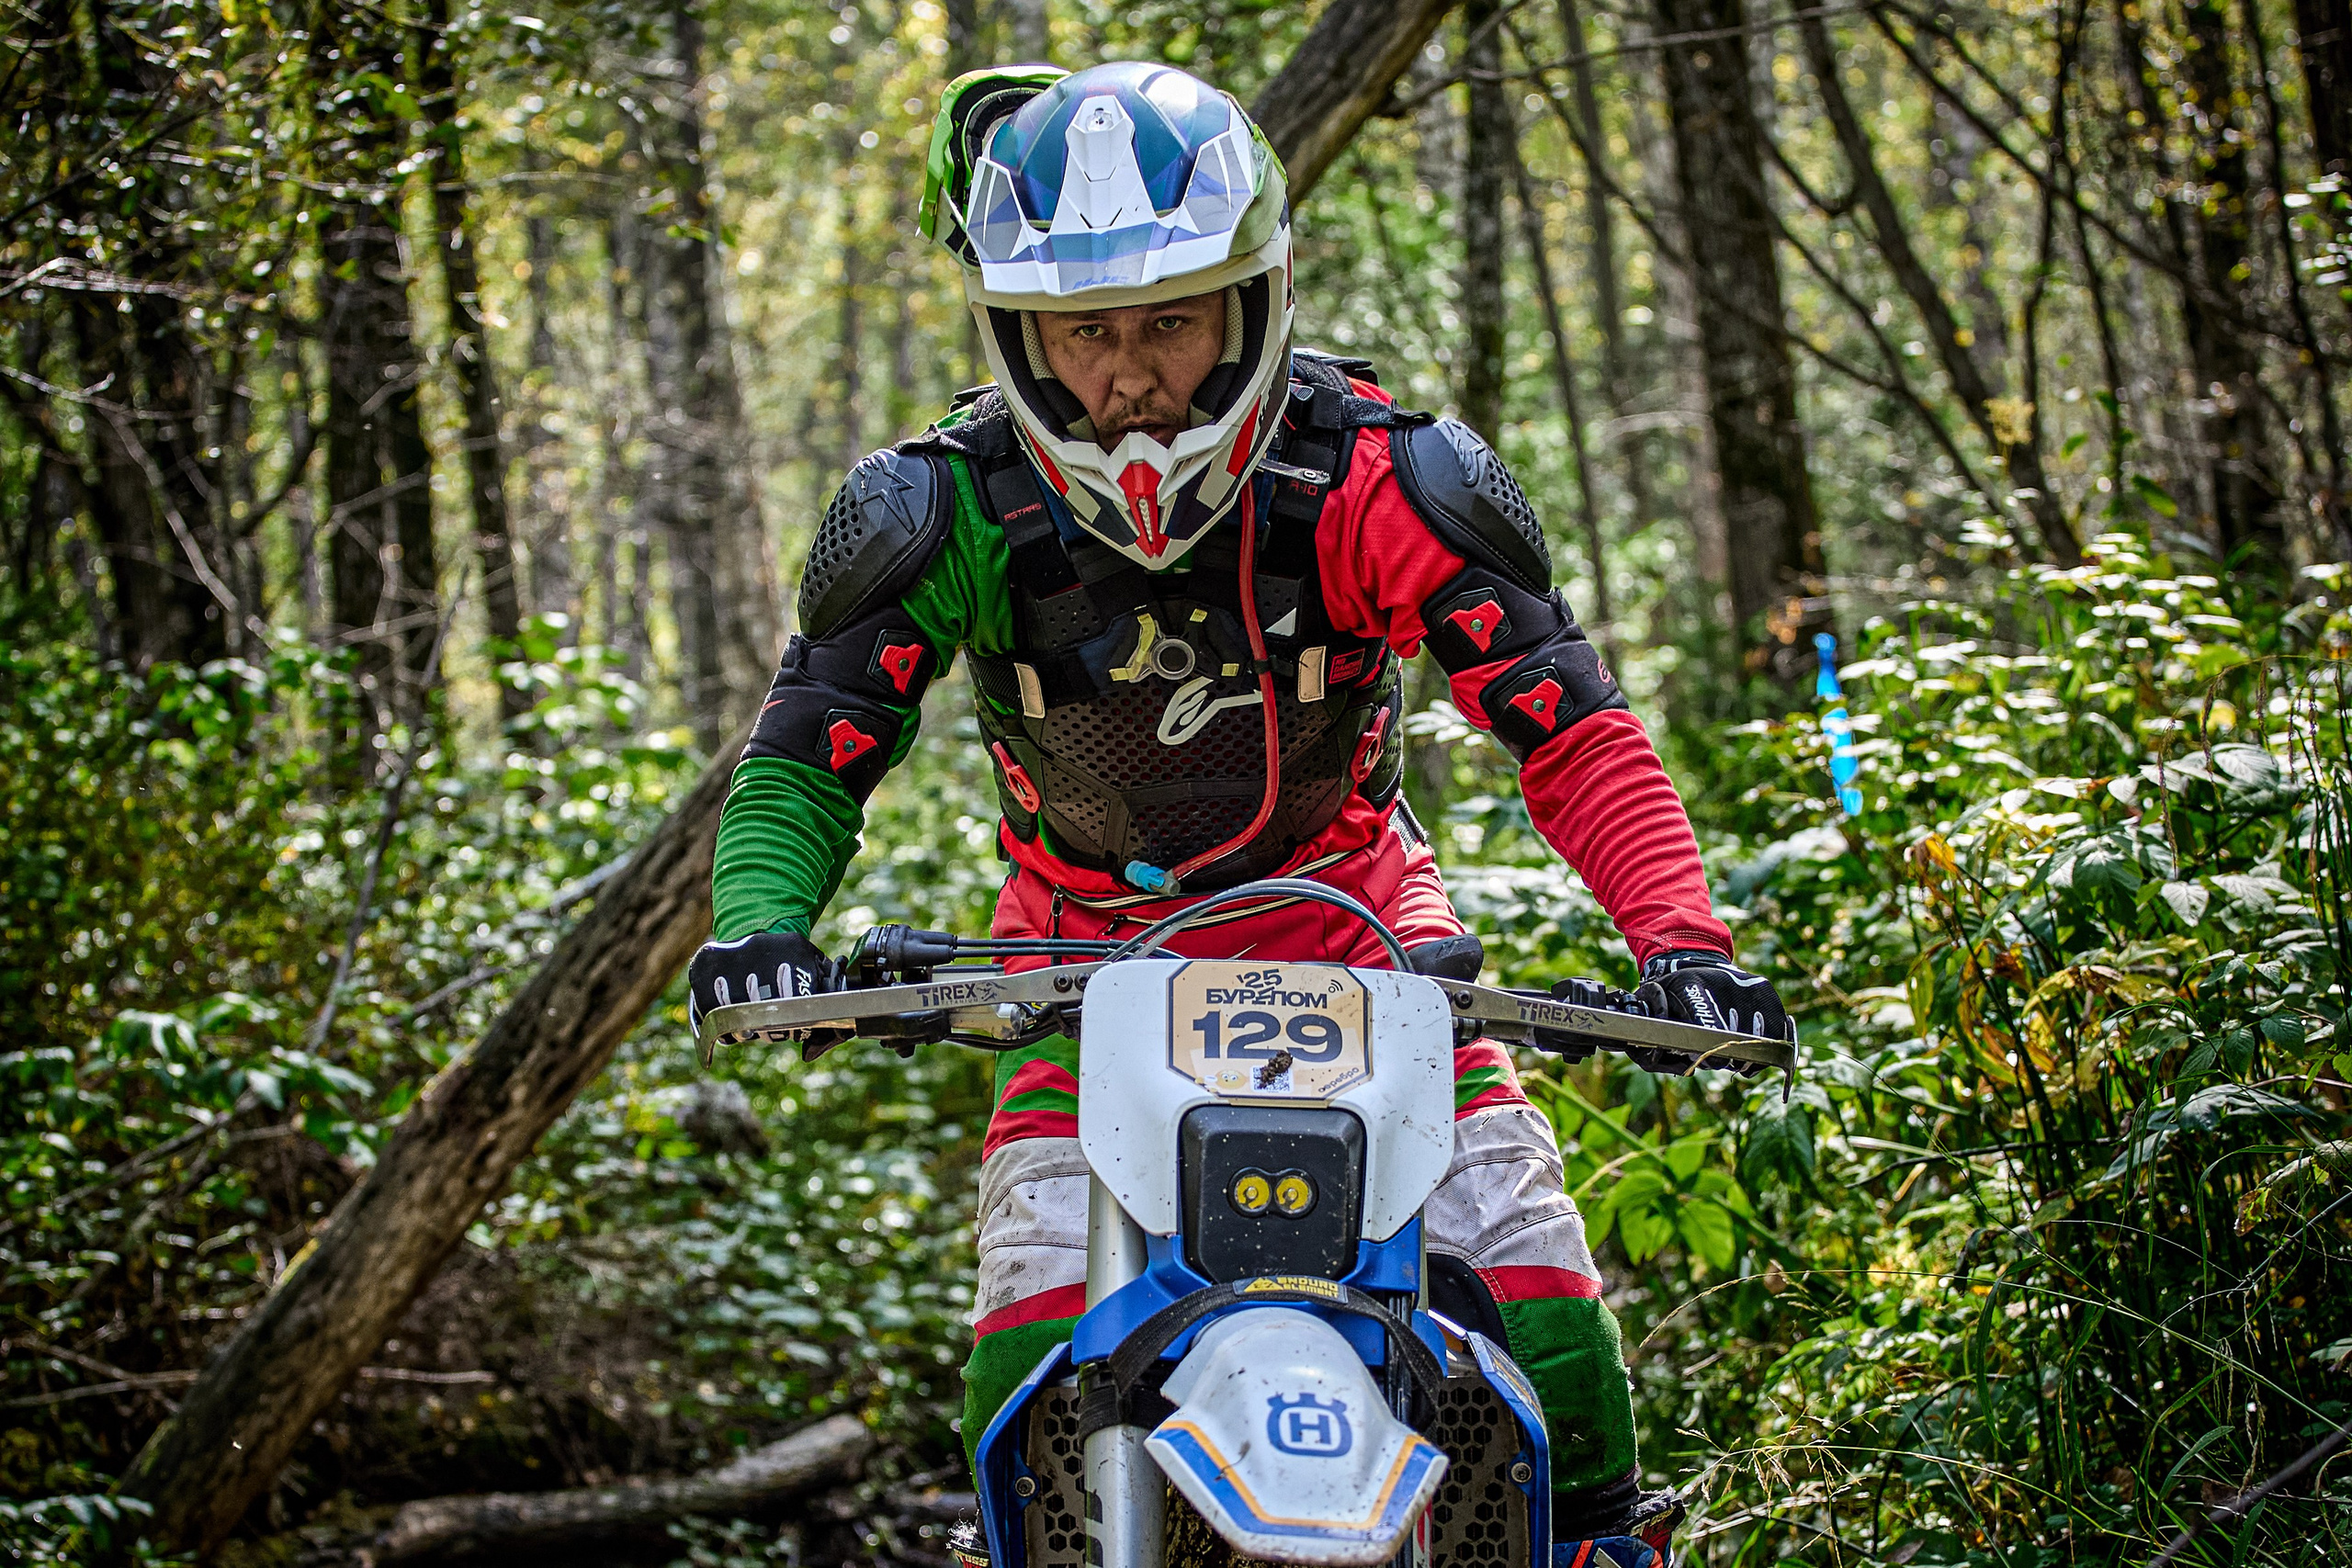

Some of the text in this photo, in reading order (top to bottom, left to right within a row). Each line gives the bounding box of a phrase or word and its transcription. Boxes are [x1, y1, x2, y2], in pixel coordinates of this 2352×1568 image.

[1206, 986, 1328, 1009] БУРЕЛОМ
[1684, 984, 1718, 1029] THOUSE
[1193, 1010, 1343, 1063] 129
[1276, 1276, 1339, 1292] ENDURO
[1283, 1283, 1339, 1299] ELEMENT
[1288, 1412, 1332, 1446] H
